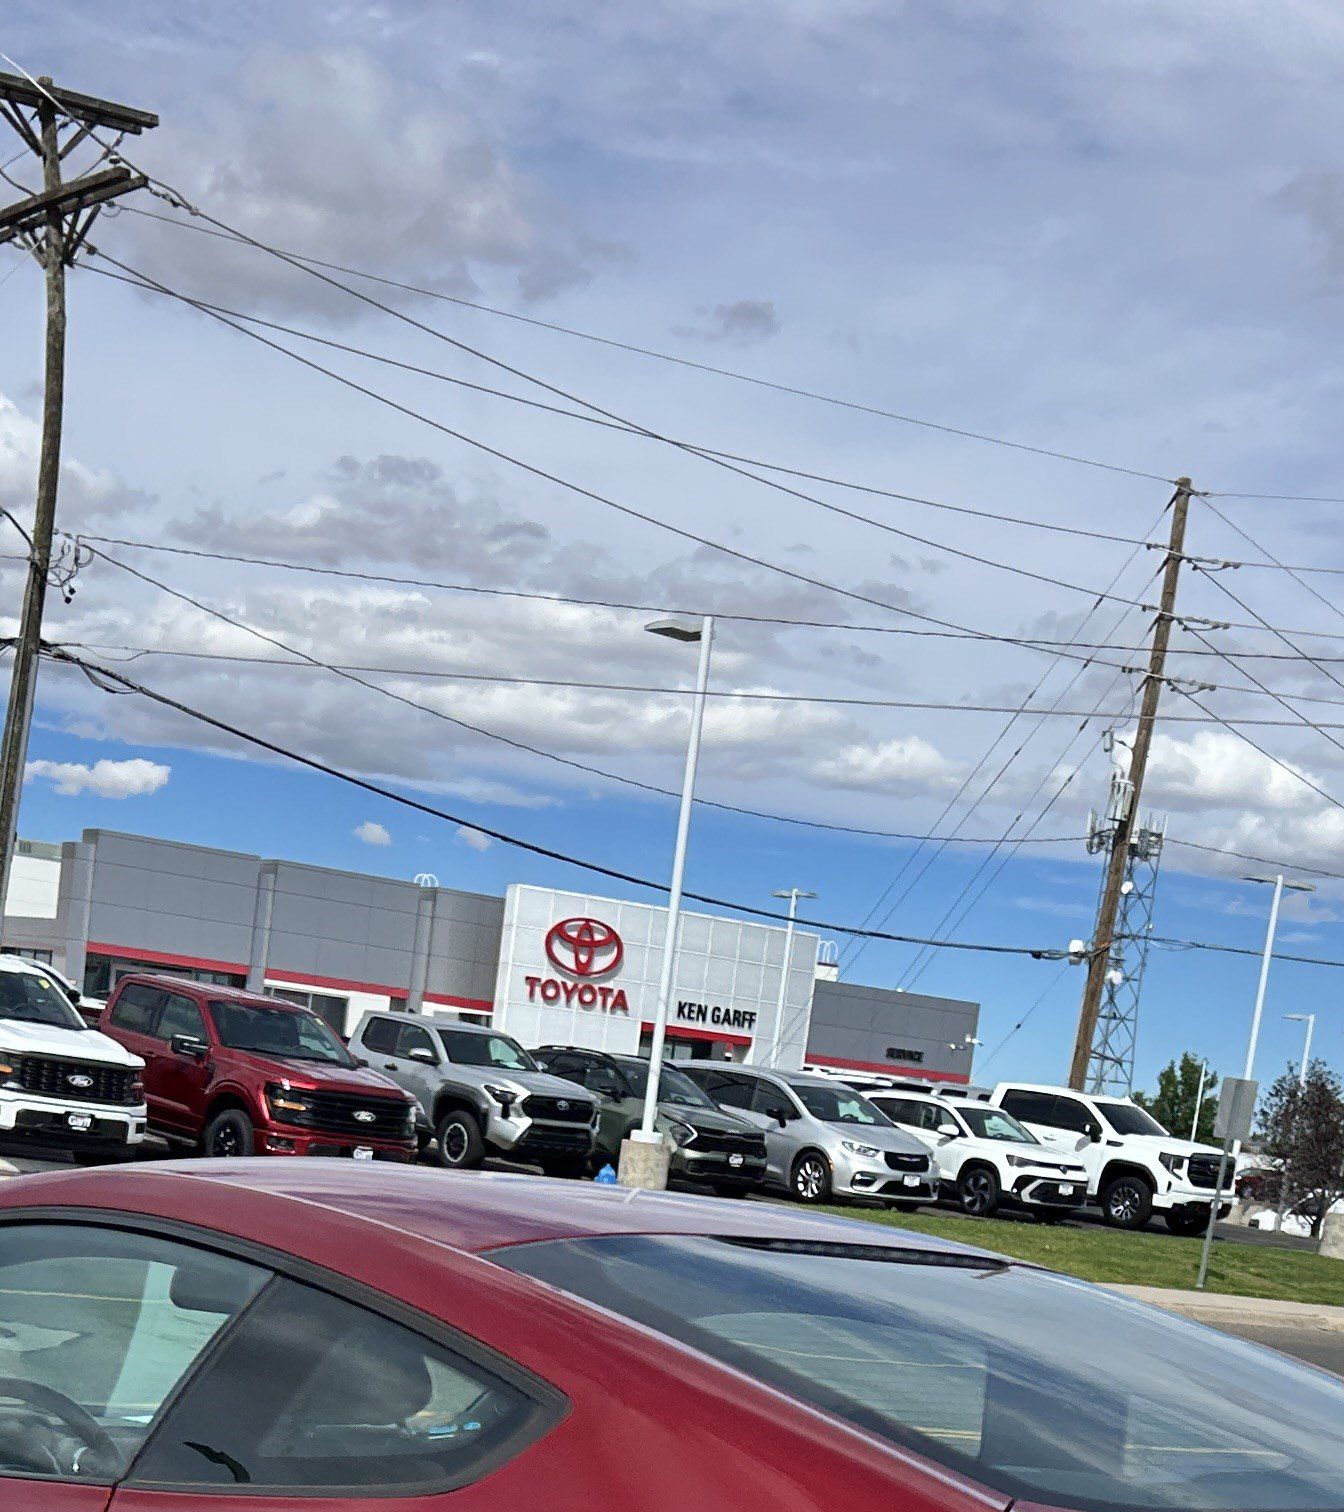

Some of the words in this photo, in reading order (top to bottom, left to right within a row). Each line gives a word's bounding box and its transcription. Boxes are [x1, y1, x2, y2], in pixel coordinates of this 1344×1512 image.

[525, 976, 629, 1016] TOYOTA
[677, 1001, 706, 1022] KEN
[711, 1006, 757, 1030] GARFF
